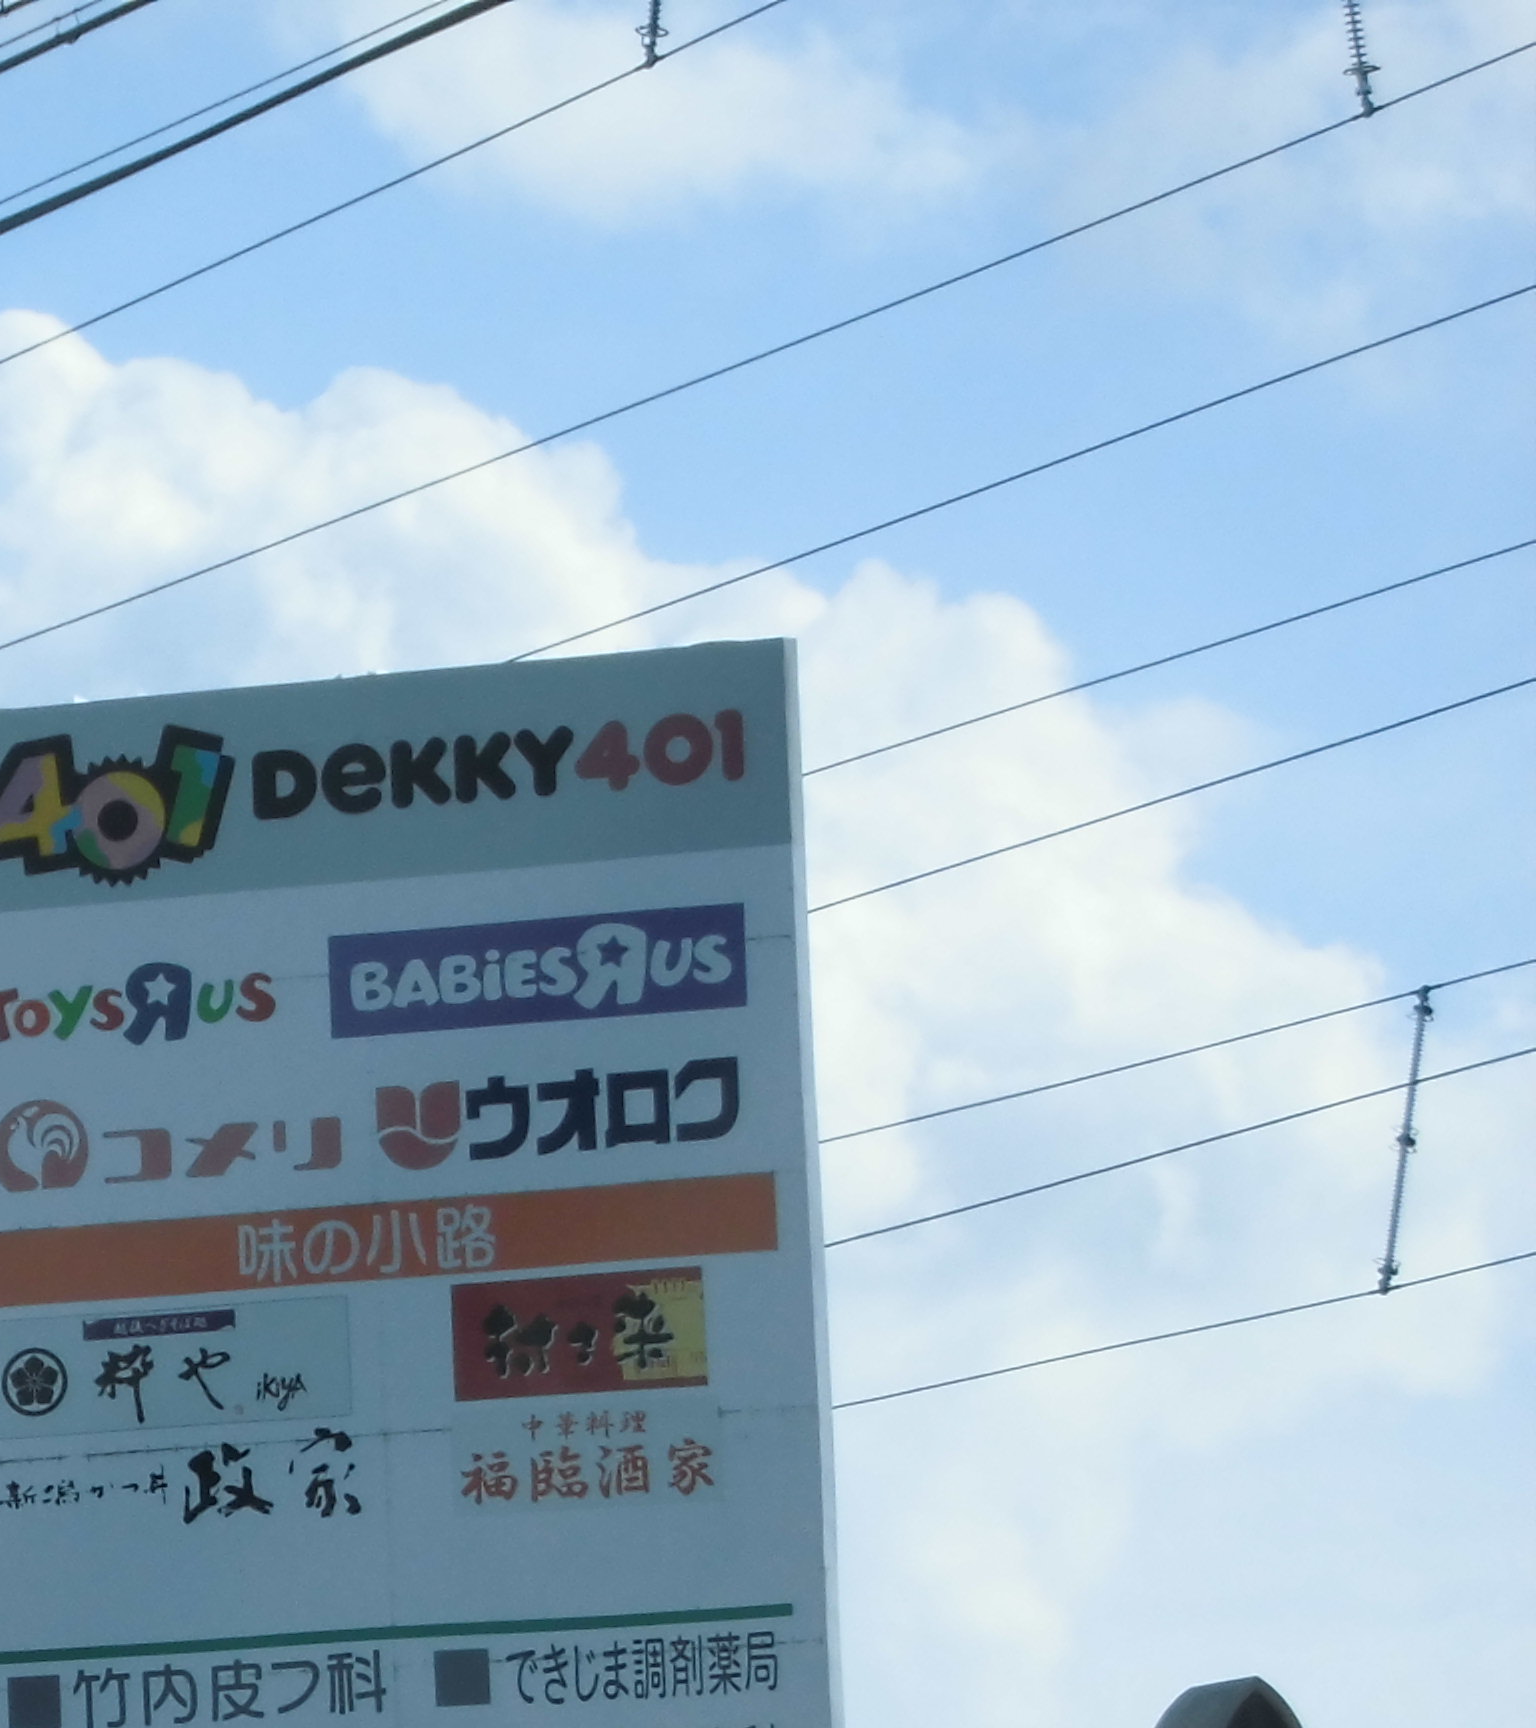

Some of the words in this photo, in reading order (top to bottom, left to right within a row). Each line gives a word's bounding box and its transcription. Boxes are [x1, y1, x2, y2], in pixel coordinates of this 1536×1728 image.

[465, 1056, 739, 1161] ウオロク
[103, 1116, 342, 1184] コメリ
[237, 1206, 497, 1279] 味の小路
[521, 1409, 649, 1441] 中華料理
[460, 1437, 716, 1505] 福臨酒家
[505, 1631, 779, 1705] できじま調剤薬局
